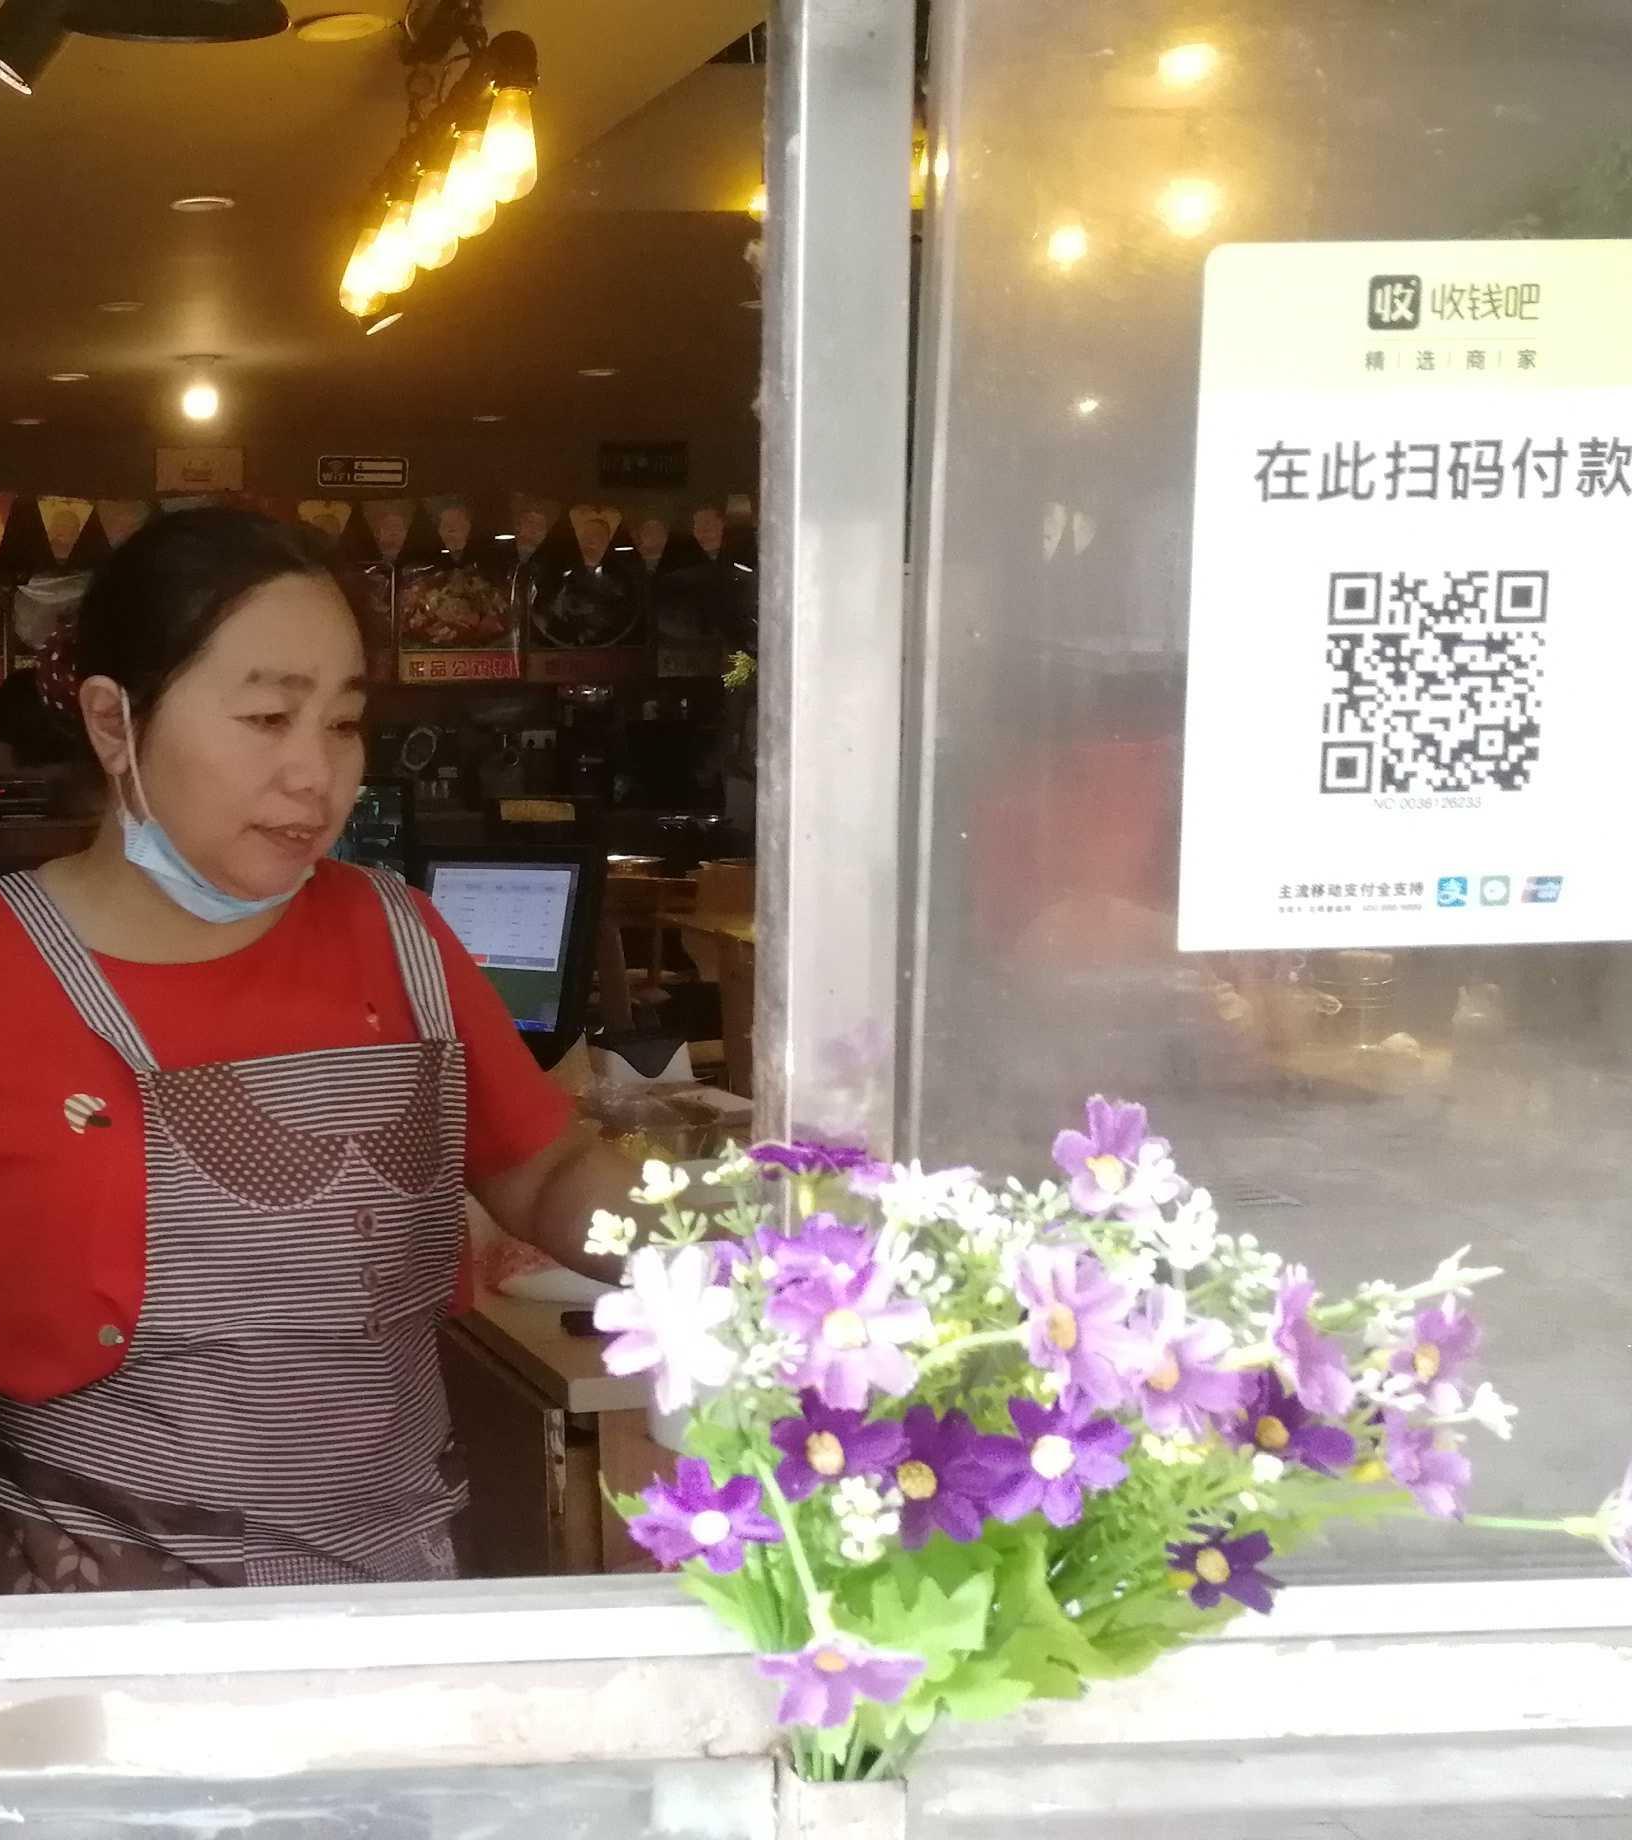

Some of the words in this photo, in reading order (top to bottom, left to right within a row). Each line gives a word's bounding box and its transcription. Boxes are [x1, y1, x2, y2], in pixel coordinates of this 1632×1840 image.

[1374, 283, 1415, 322] 收
[1431, 283, 1540, 320] 收钱吧
[1254, 436, 1632, 502] 在此扫码付款
[1279, 881, 1423, 899] 主流移动支付全支持
